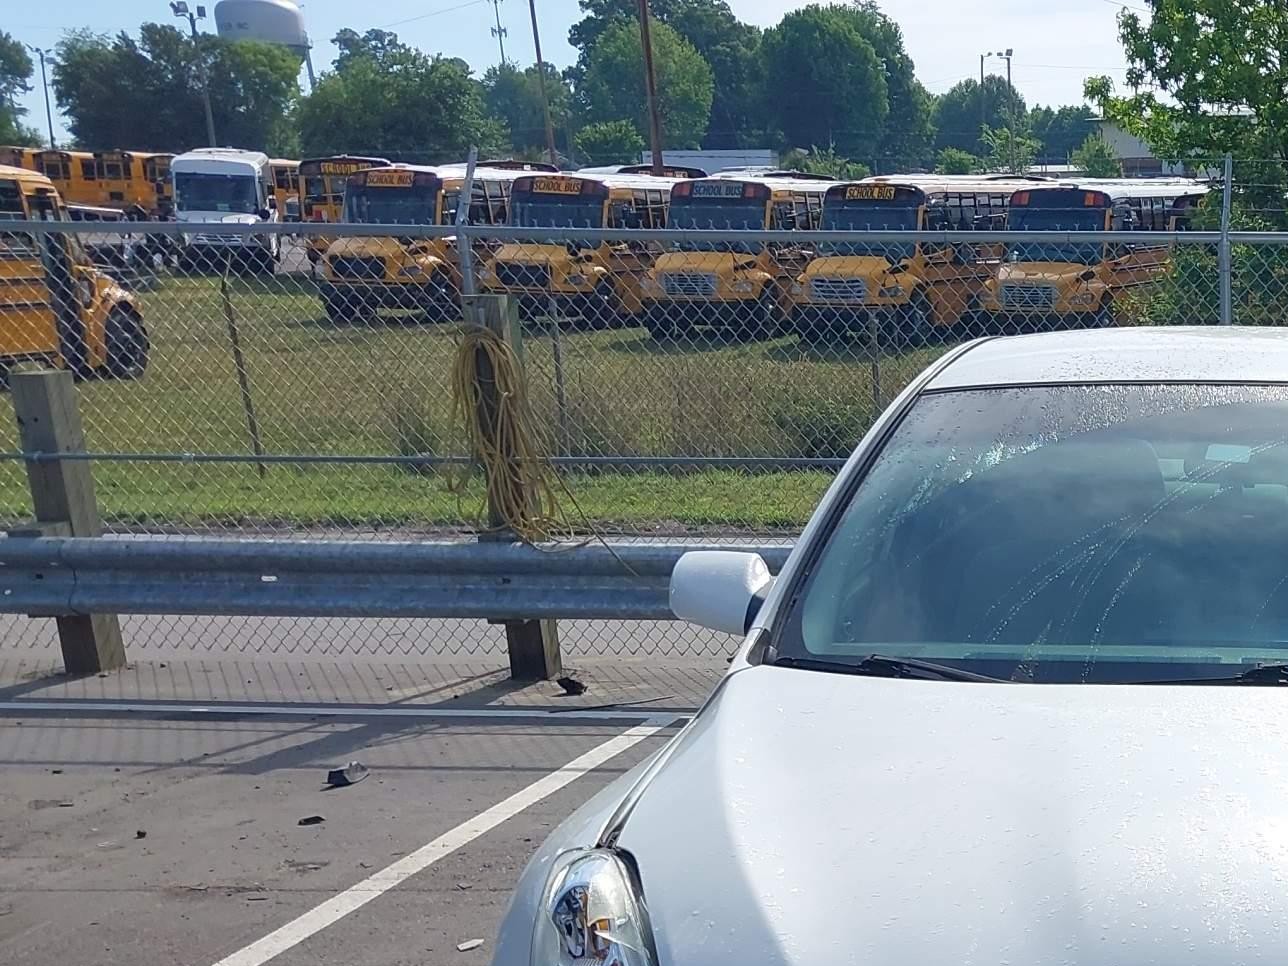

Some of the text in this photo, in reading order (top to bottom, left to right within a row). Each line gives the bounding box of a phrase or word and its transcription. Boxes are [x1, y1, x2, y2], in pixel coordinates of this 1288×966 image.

[367, 173, 413, 185] SCHOOL BUS
[534, 180, 581, 193] SCHOOL BUS
[694, 184, 742, 196] SCHOOL BUS
[847, 186, 894, 199] SCHOOL BUS
